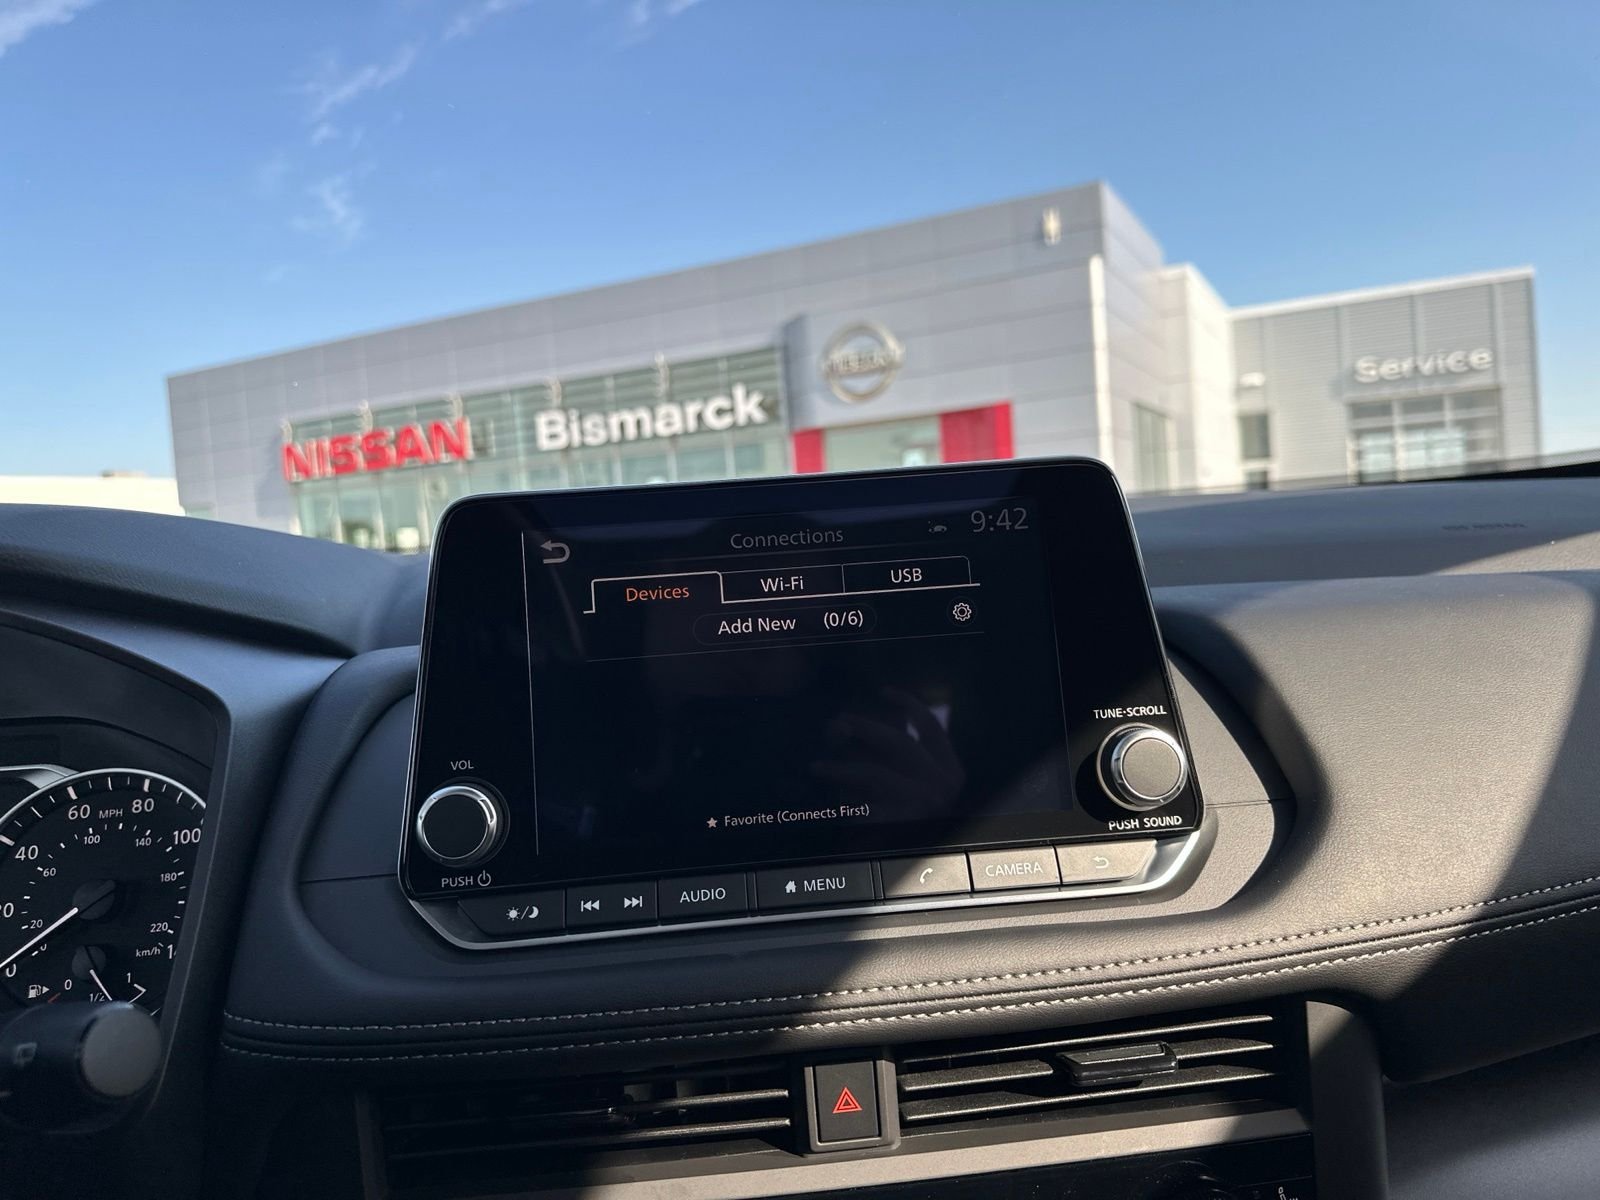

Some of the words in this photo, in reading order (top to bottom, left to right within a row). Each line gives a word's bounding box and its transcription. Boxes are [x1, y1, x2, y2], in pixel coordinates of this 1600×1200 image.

[1353, 347, 1494, 384] Service
[534, 383, 767, 451] Bismarck
[282, 417, 472, 482] NISSAN
[969, 506, 1029, 534] 9:42
[730, 526, 844, 551] Connections
[889, 566, 923, 585] USB
[625, 583, 690, 603] Devices
[760, 575, 805, 594] Wi-Fi
[718, 617, 752, 636] Add
[756, 615, 797, 633] New
[822, 609, 865, 632] (0/6)
[450, 759, 475, 772] VOL
[67, 804, 91, 821] 60
[98, 808, 124, 820] MPH
[131, 798, 155, 814] 80
[723, 813, 775, 828] Favorite
[777, 807, 838, 825] (Connects
[840, 802, 870, 819] First)
[1108, 819, 1140, 831] PUSH
[1143, 815, 1183, 829] SOUND
[83, 834, 101, 846] 100
[135, 836, 153, 848] 140
[172, 827, 202, 846] 100
[14, 844, 39, 861] 40
[42, 866, 57, 878] 60
[160, 872, 178, 883] 180
[985, 862, 1043, 877] CAMERA
[441, 876, 474, 889] PUSH
[803, 876, 846, 893] MENU
[679, 887, 727, 905] AUDIO
[30, 919, 44, 930] 20
[150, 922, 169, 934] 220
[135, 947, 161, 958] km/h
[64, 978, 73, 991] 0
